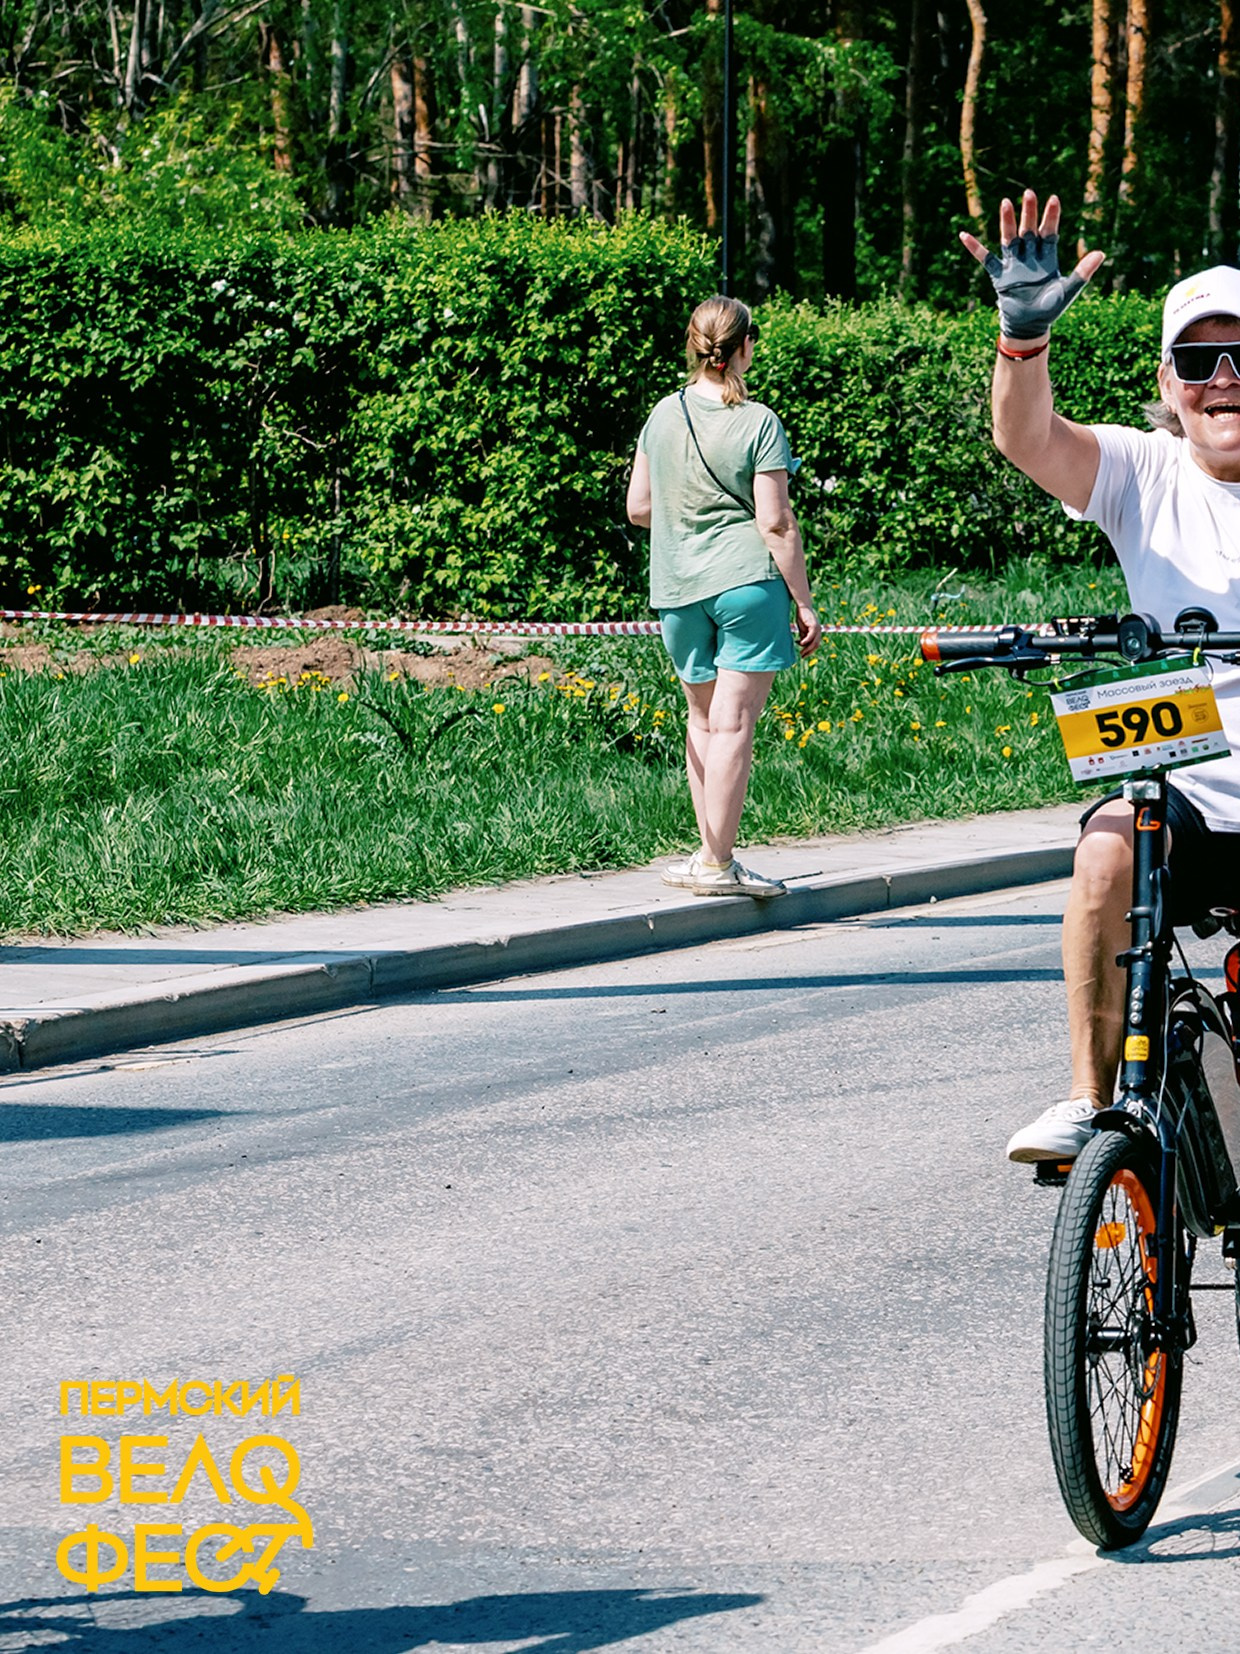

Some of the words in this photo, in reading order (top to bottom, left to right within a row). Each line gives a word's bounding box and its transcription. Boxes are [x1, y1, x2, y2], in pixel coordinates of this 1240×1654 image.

[1097, 680, 1157, 699] Массовый
[1159, 677, 1193, 689] заезд
[1095, 701, 1183, 748] 590
